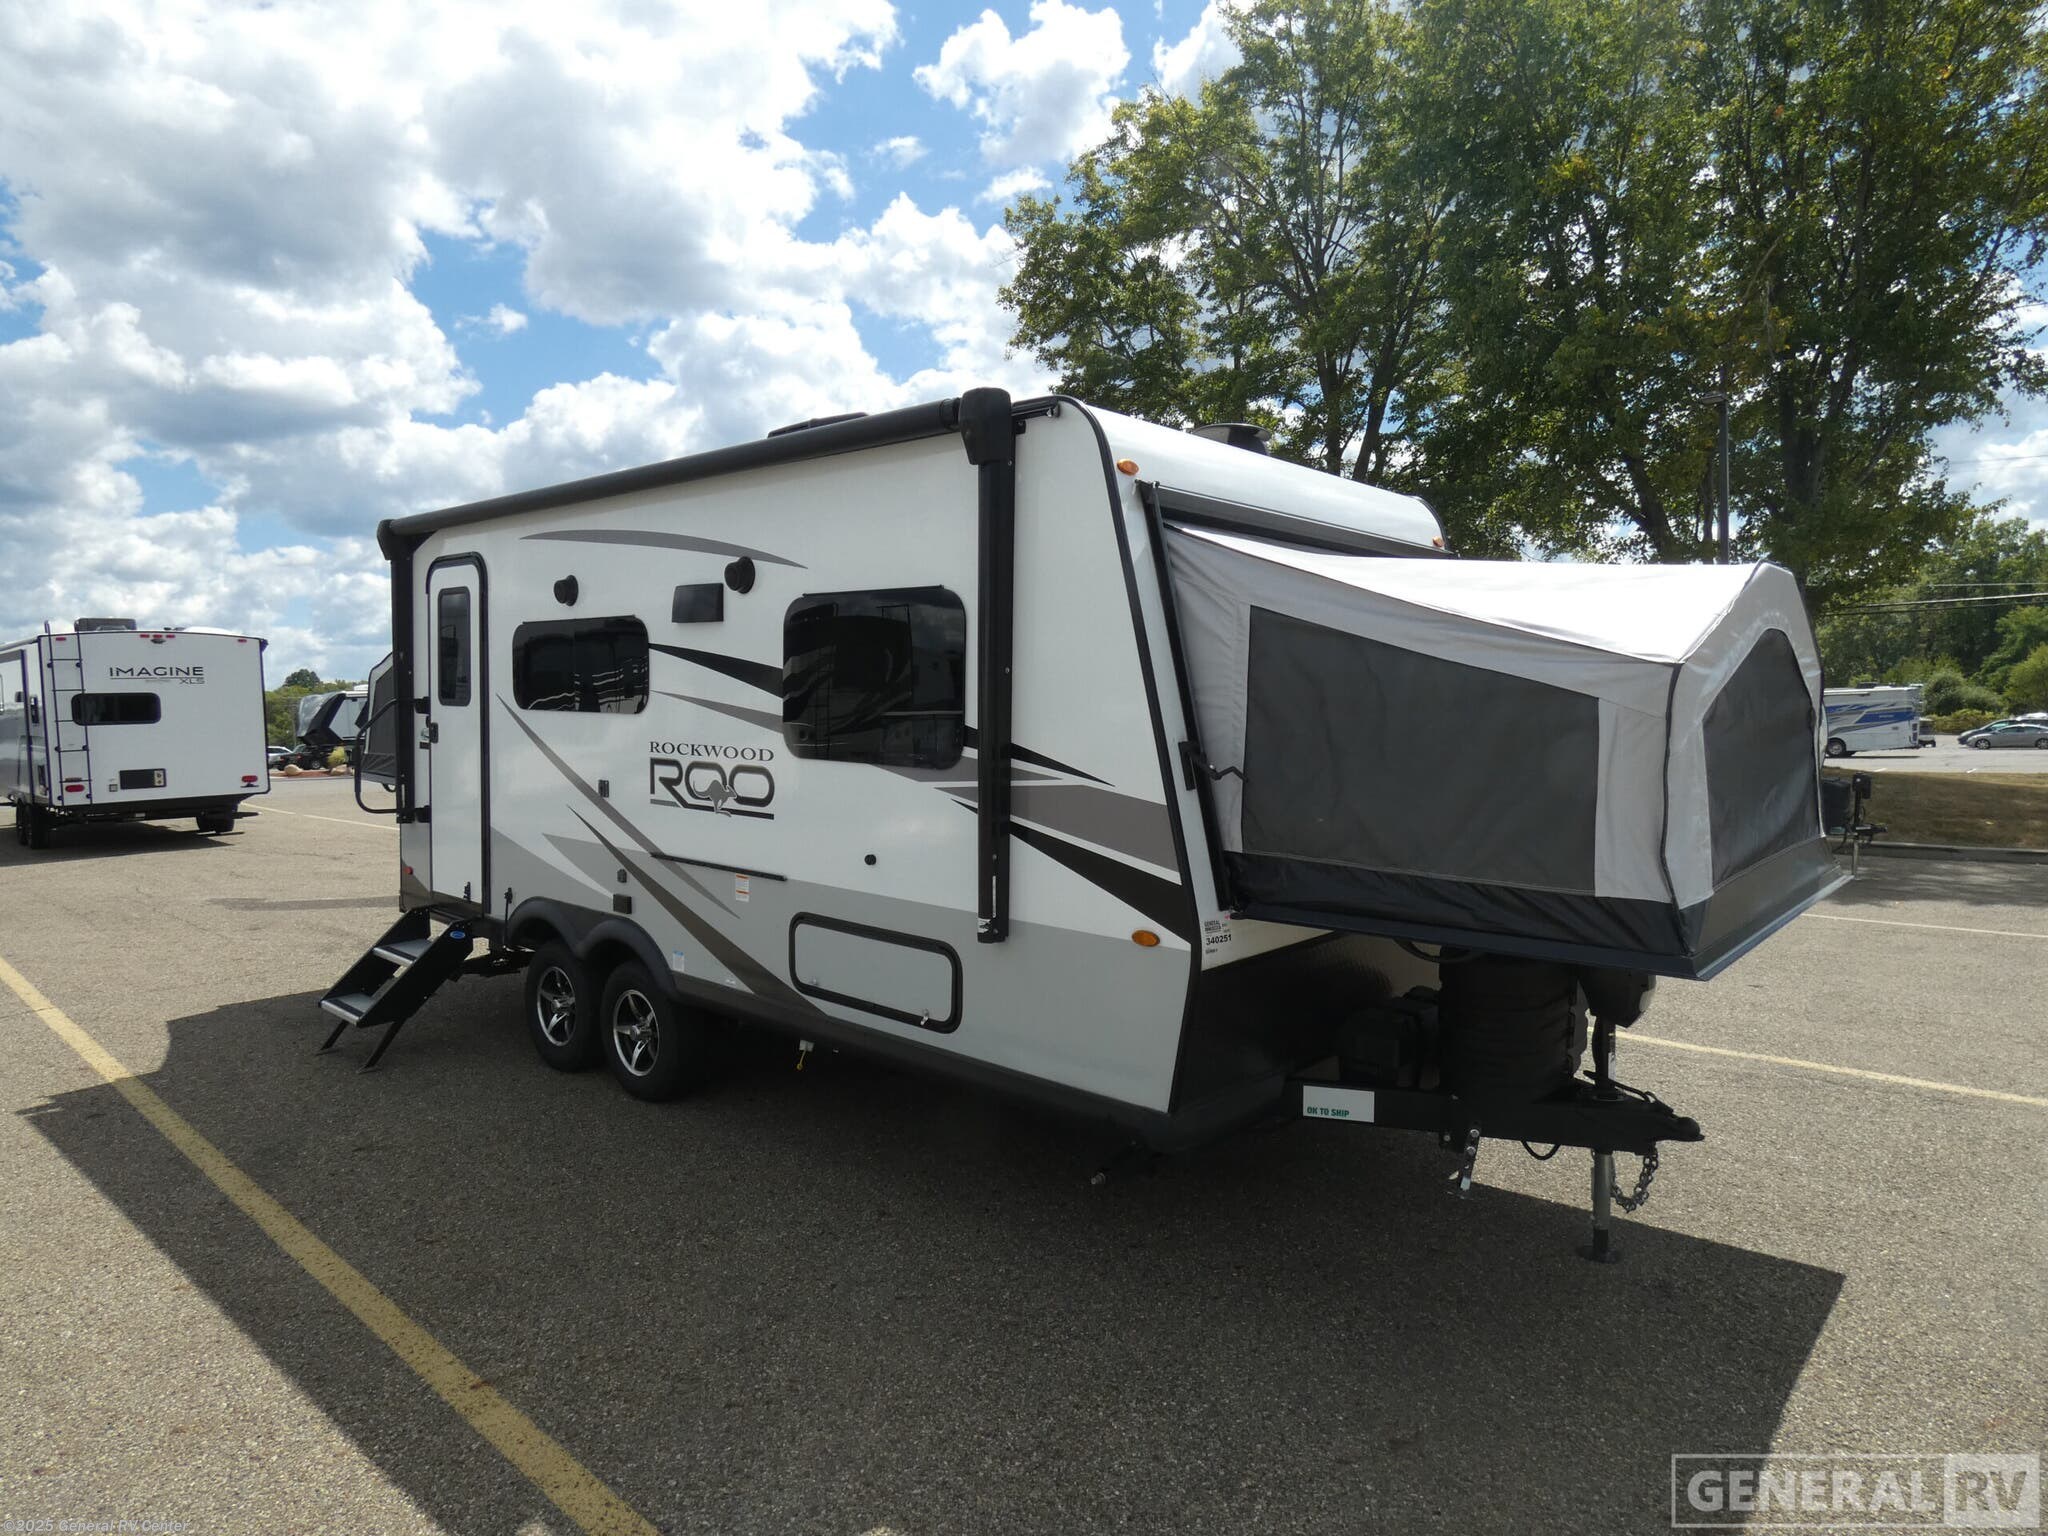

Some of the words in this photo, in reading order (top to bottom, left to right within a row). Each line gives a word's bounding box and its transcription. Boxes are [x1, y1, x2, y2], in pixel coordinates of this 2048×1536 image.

[109, 666, 204, 677] IMAGINE
[650, 741, 774, 762] ROCKWOOD
[650, 757, 775, 812] ROO
[1205, 934, 1232, 946] 340251
[1306, 1106, 1318, 1115] OK
[1320, 1107, 1330, 1116] TO
[1330, 1108, 1350, 1118] SHIP
